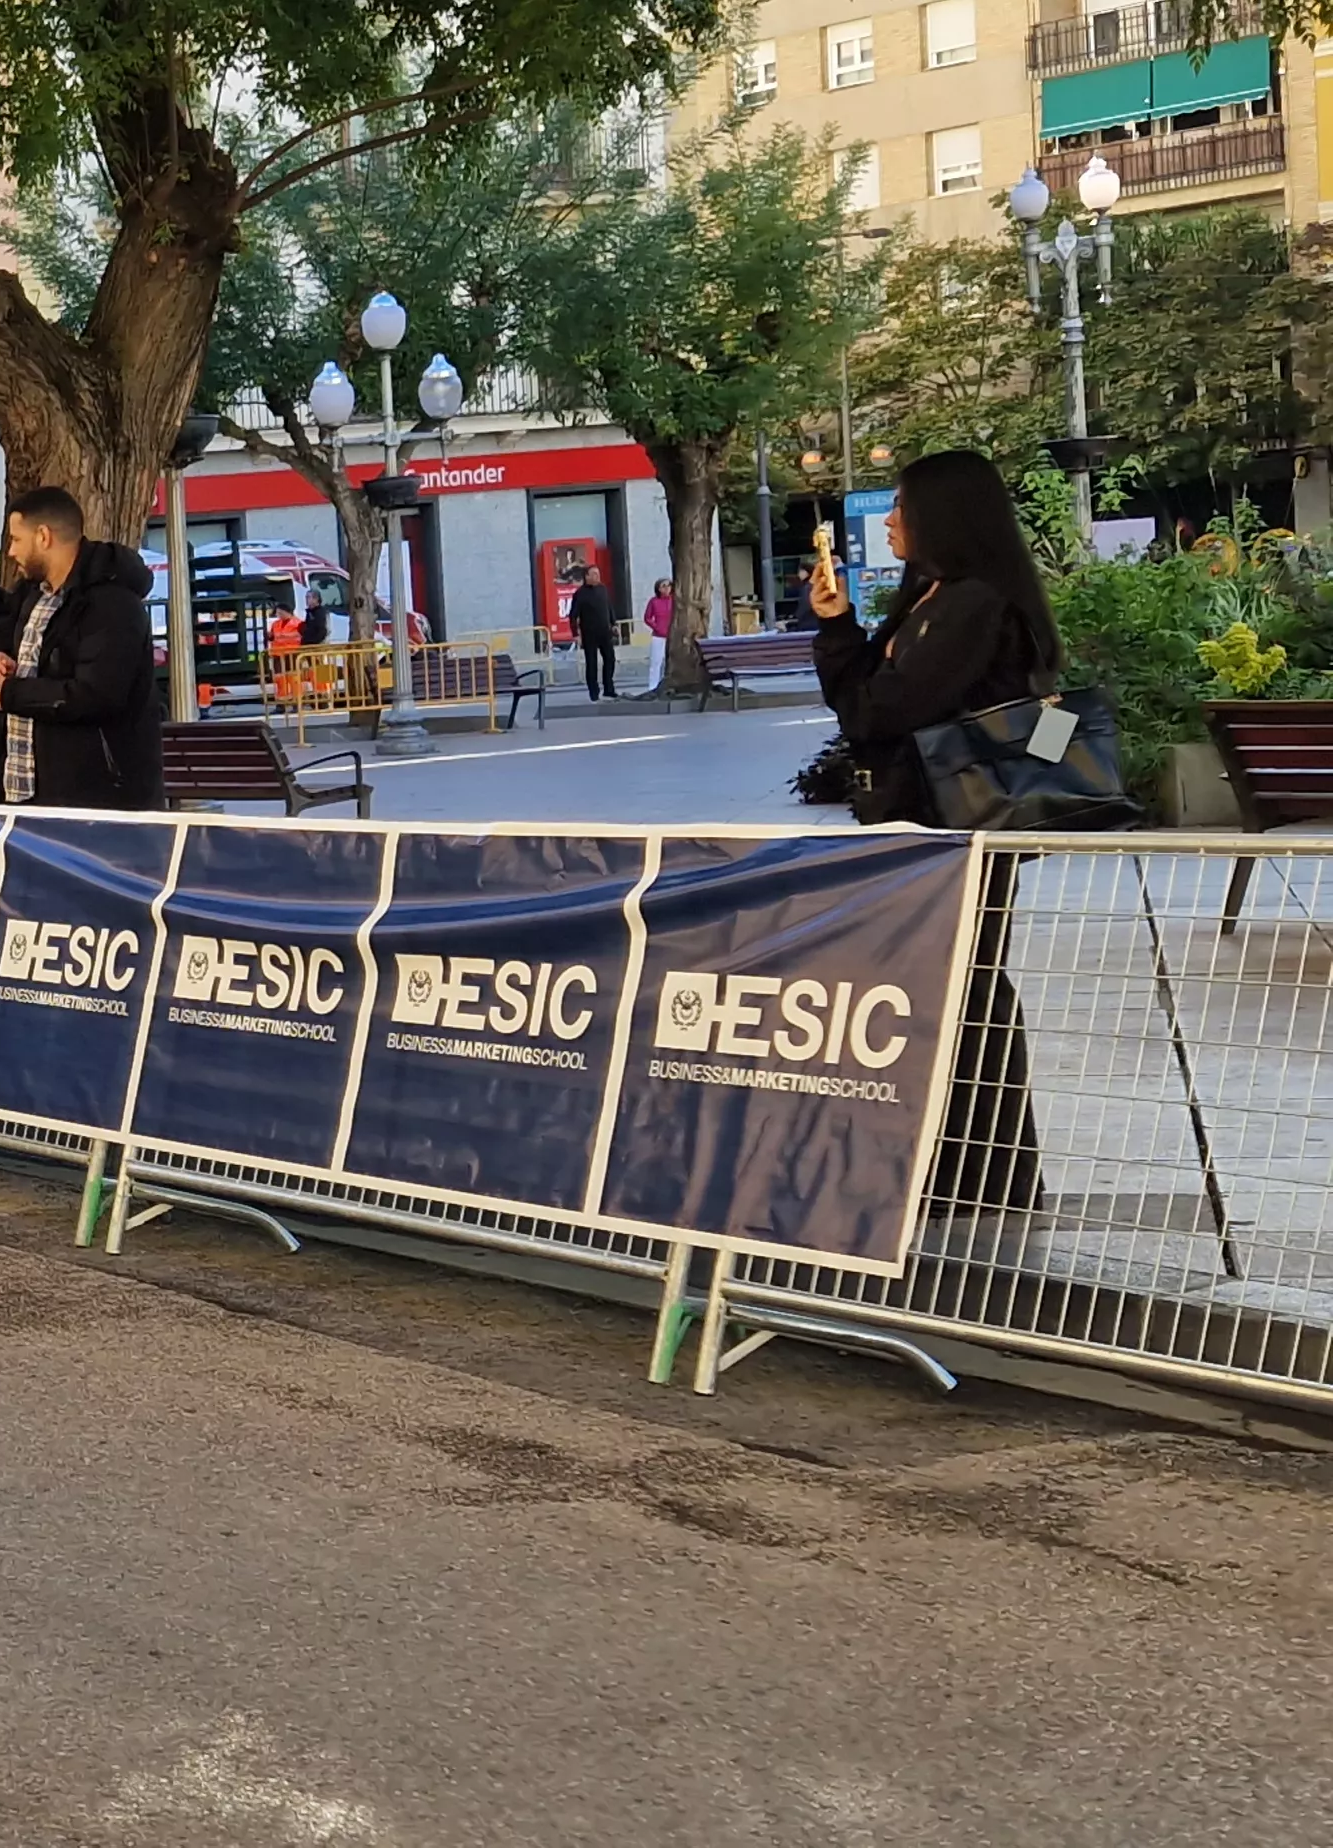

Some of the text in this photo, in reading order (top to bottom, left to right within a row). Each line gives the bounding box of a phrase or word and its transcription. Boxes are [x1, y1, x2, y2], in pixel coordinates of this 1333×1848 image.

[32, 921, 140, 992] ESIC
[216, 938, 345, 1016] ESIC
[168, 1006, 338, 1043] BUSINESS&MARKETINGSCHOOL
[441, 956, 598, 1041] ESIC
[715, 973, 912, 1070] ESIC
[387, 1032, 589, 1071] BUSINESS&MARKETINGSCHOOL
[648, 1059, 901, 1104] BUSINESS&MARKETINGSCHOOL
